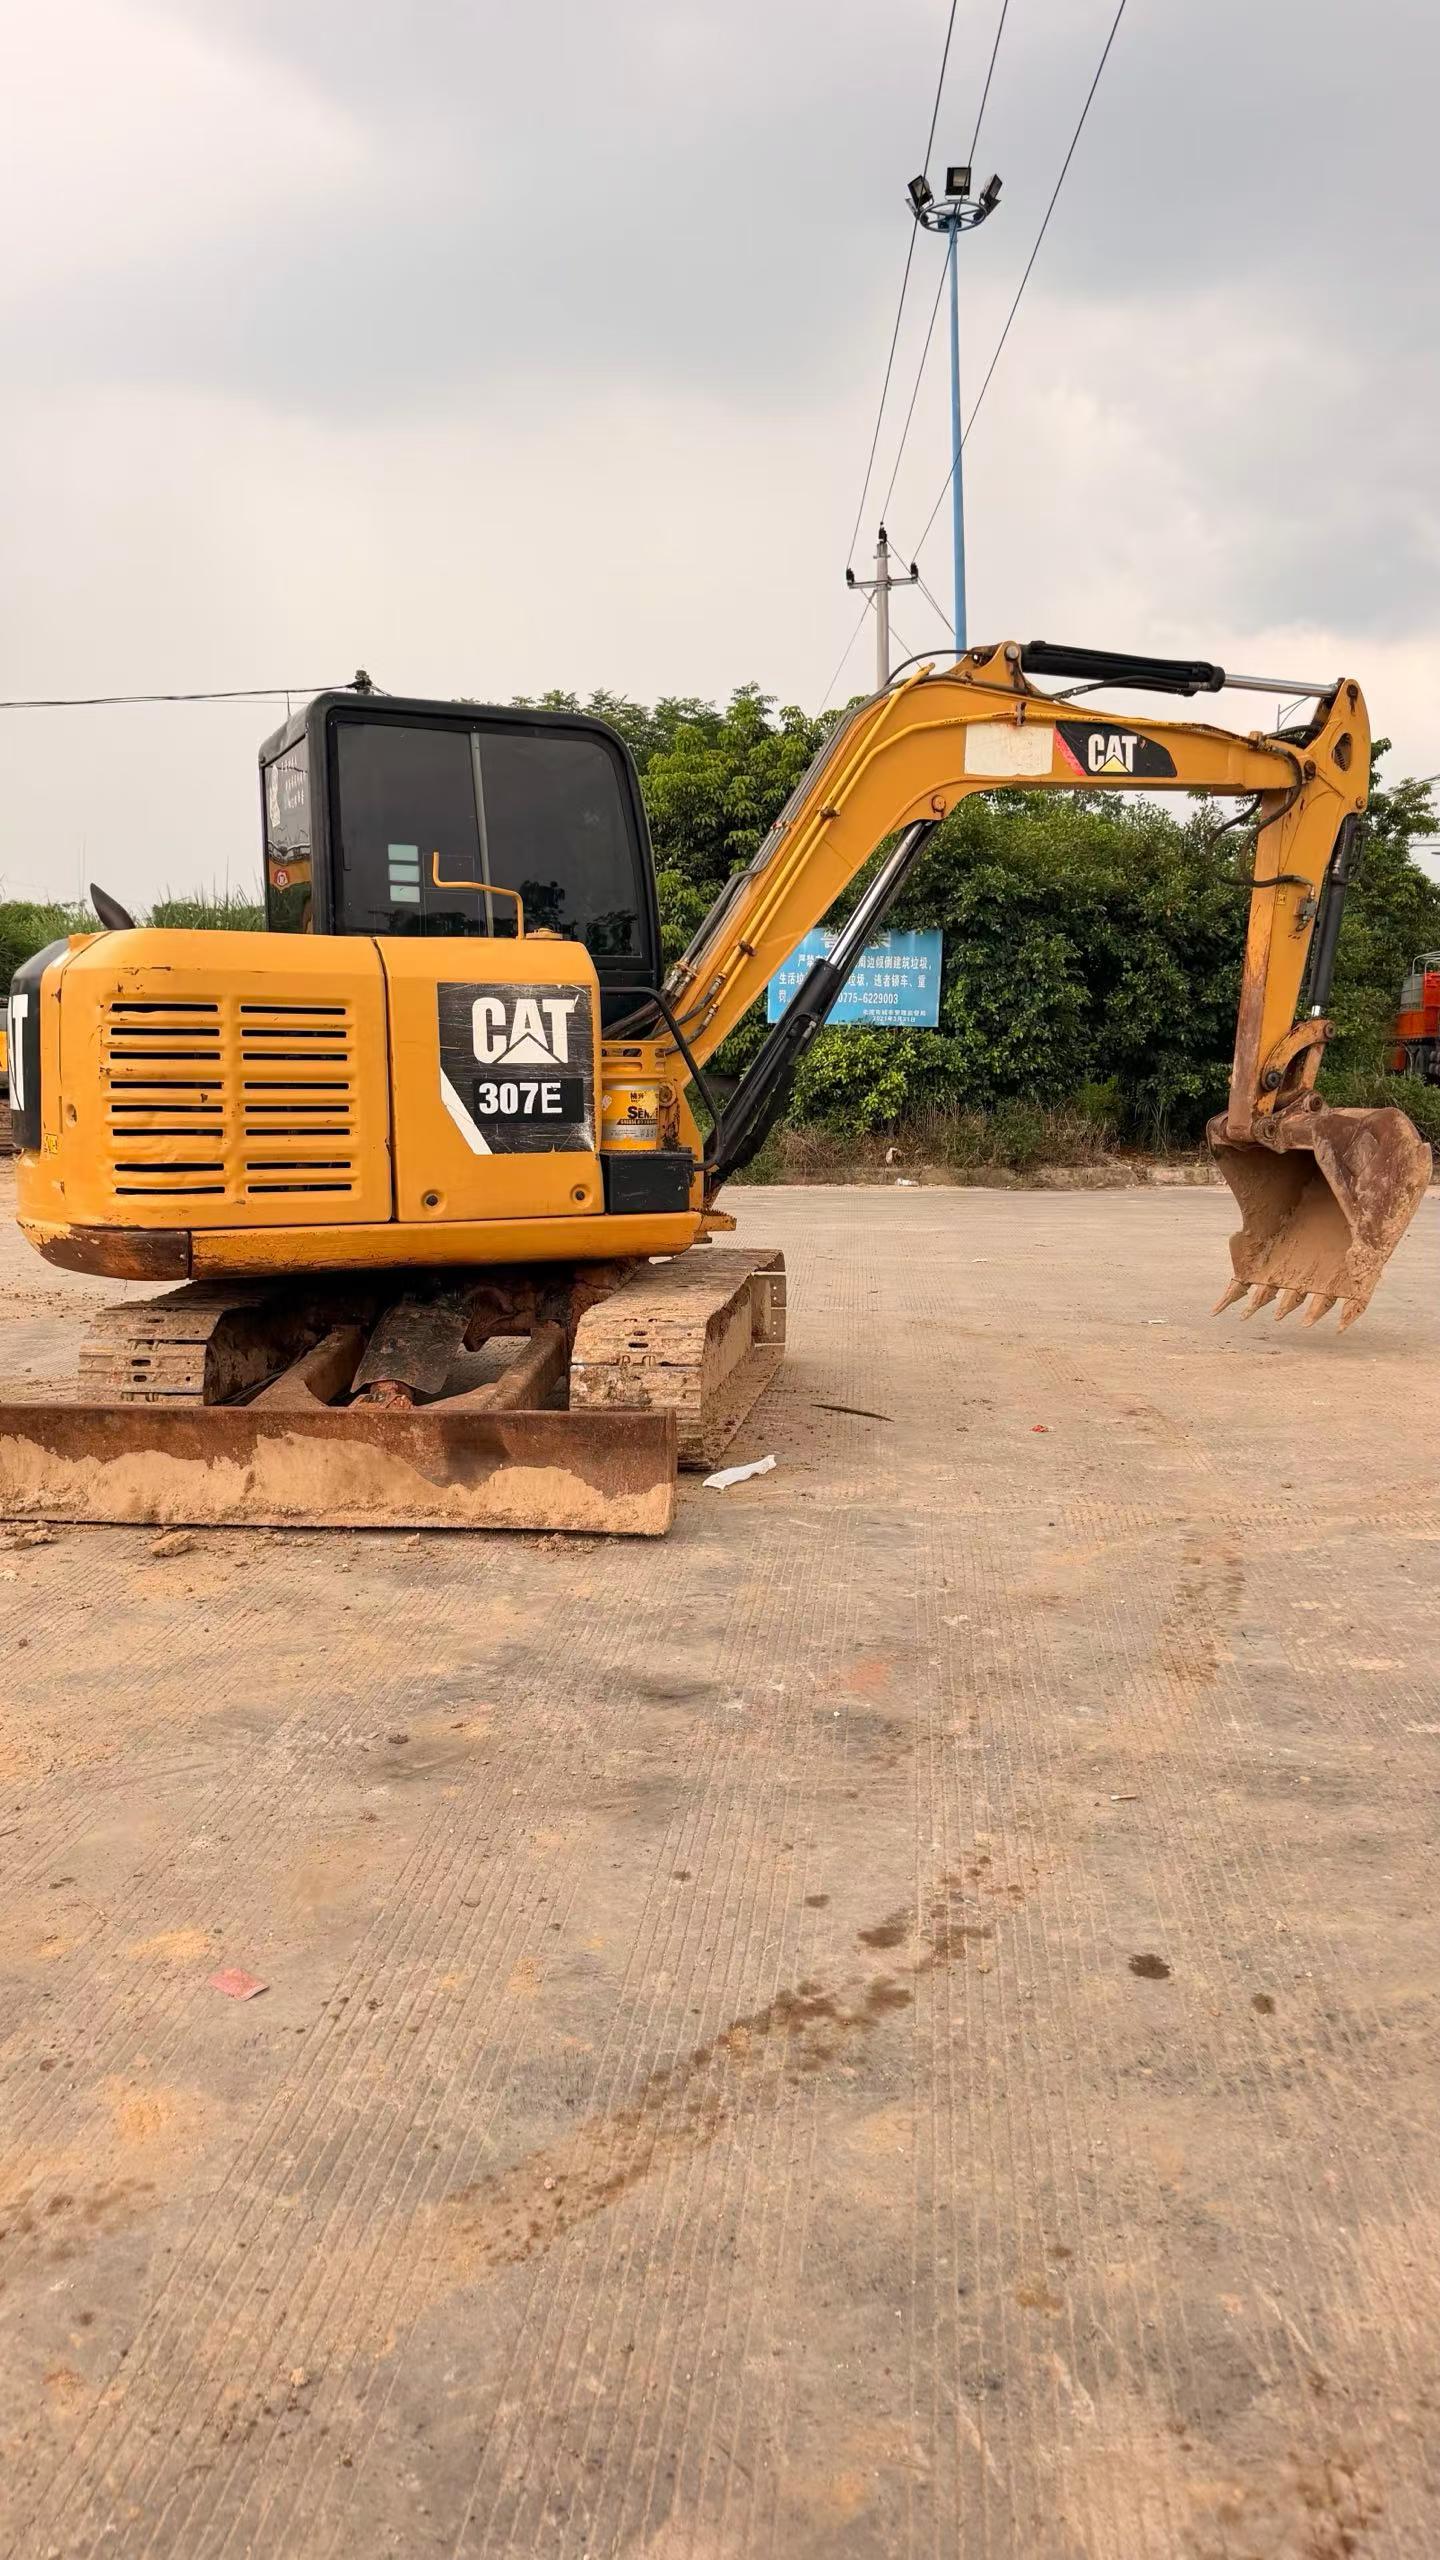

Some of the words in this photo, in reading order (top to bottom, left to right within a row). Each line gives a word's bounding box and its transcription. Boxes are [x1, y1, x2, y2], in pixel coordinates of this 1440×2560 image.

[1088, 734, 1138, 773] CAT
[472, 997, 576, 1064] CAT
[478, 1082, 563, 1114] 307E
